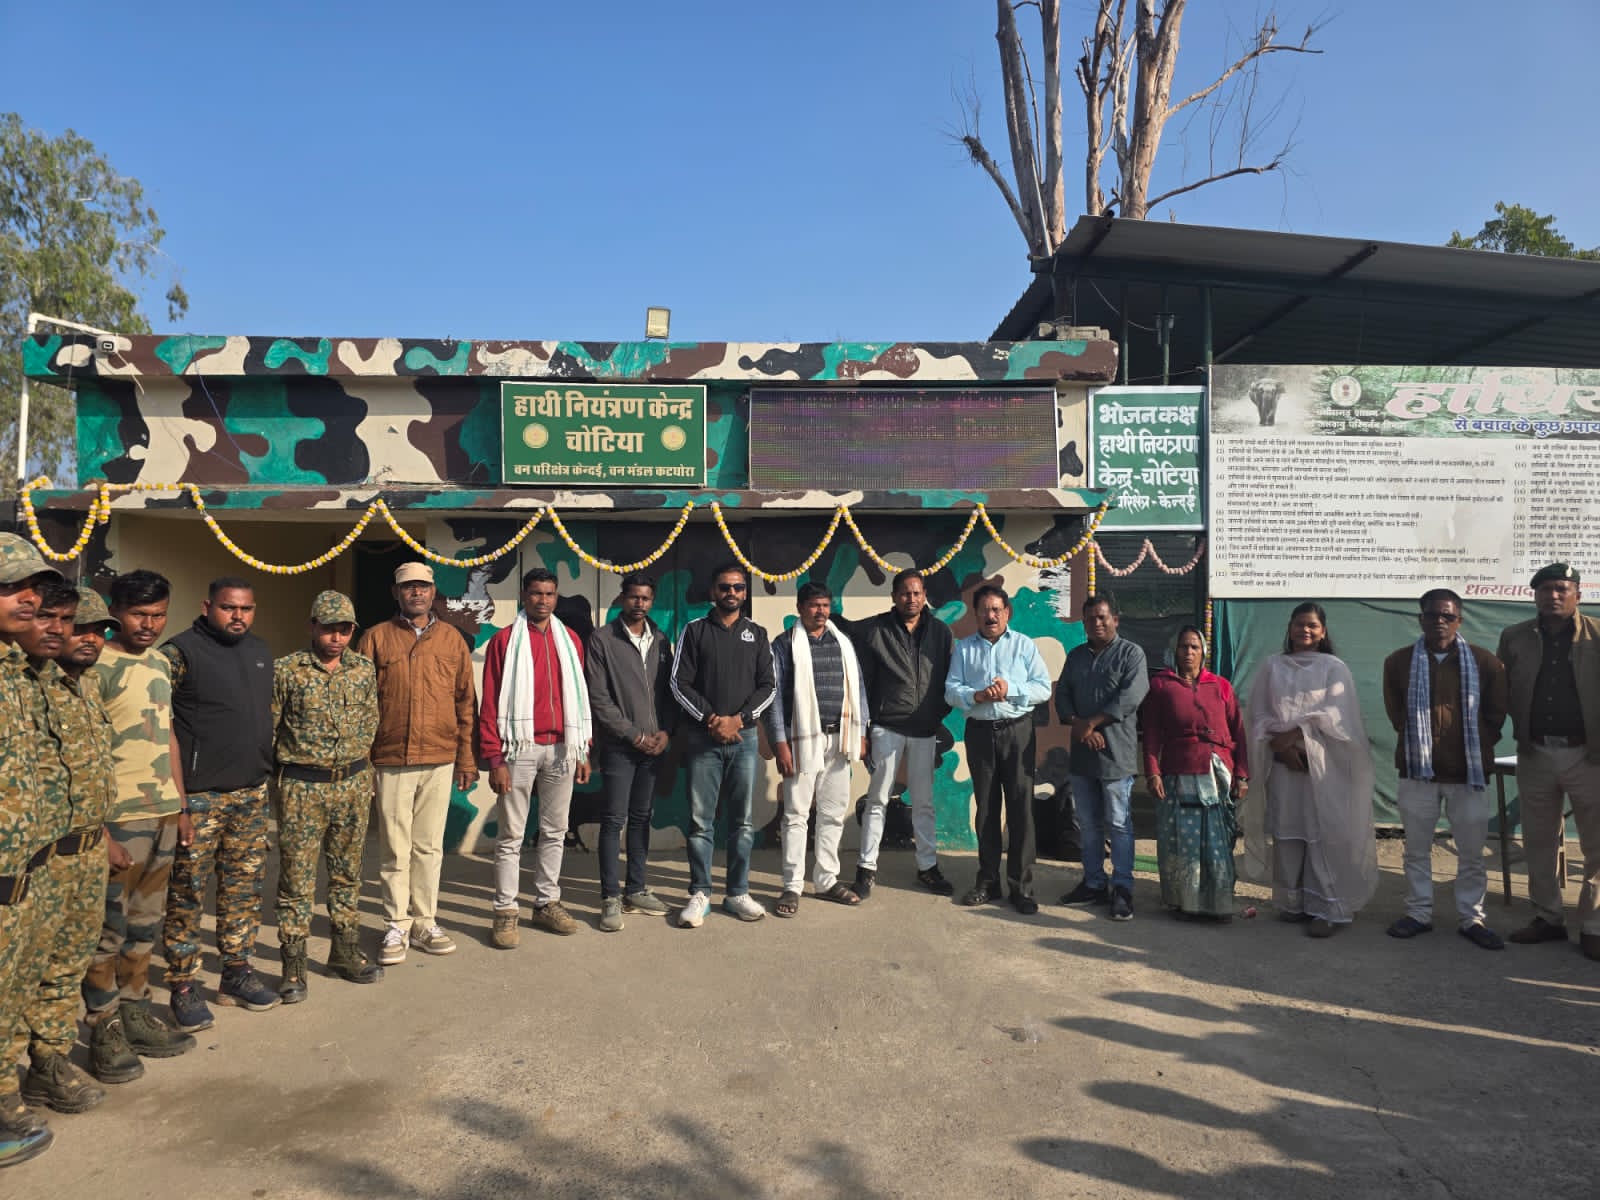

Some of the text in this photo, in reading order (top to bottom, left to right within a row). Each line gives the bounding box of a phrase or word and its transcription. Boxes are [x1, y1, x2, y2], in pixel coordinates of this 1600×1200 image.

[513, 390, 695, 420] हाथी नियंत्रण केन्द्र
[1098, 401, 1199, 426] भोजन कक्ष
[565, 424, 645, 453] चोटिया
[1454, 416, 1468, 431] से
[1472, 418, 1513, 432] बचाव
[1516, 416, 1531, 432] के
[1532, 419, 1561, 437] कुछ
[1098, 427, 1200, 458] हाथी नियंत्रण
[513, 464, 530, 476] वन
[533, 461, 570, 477] परिक्षेत्र
[609, 465, 625, 477] वन
[627, 463, 653, 477] मंडल
